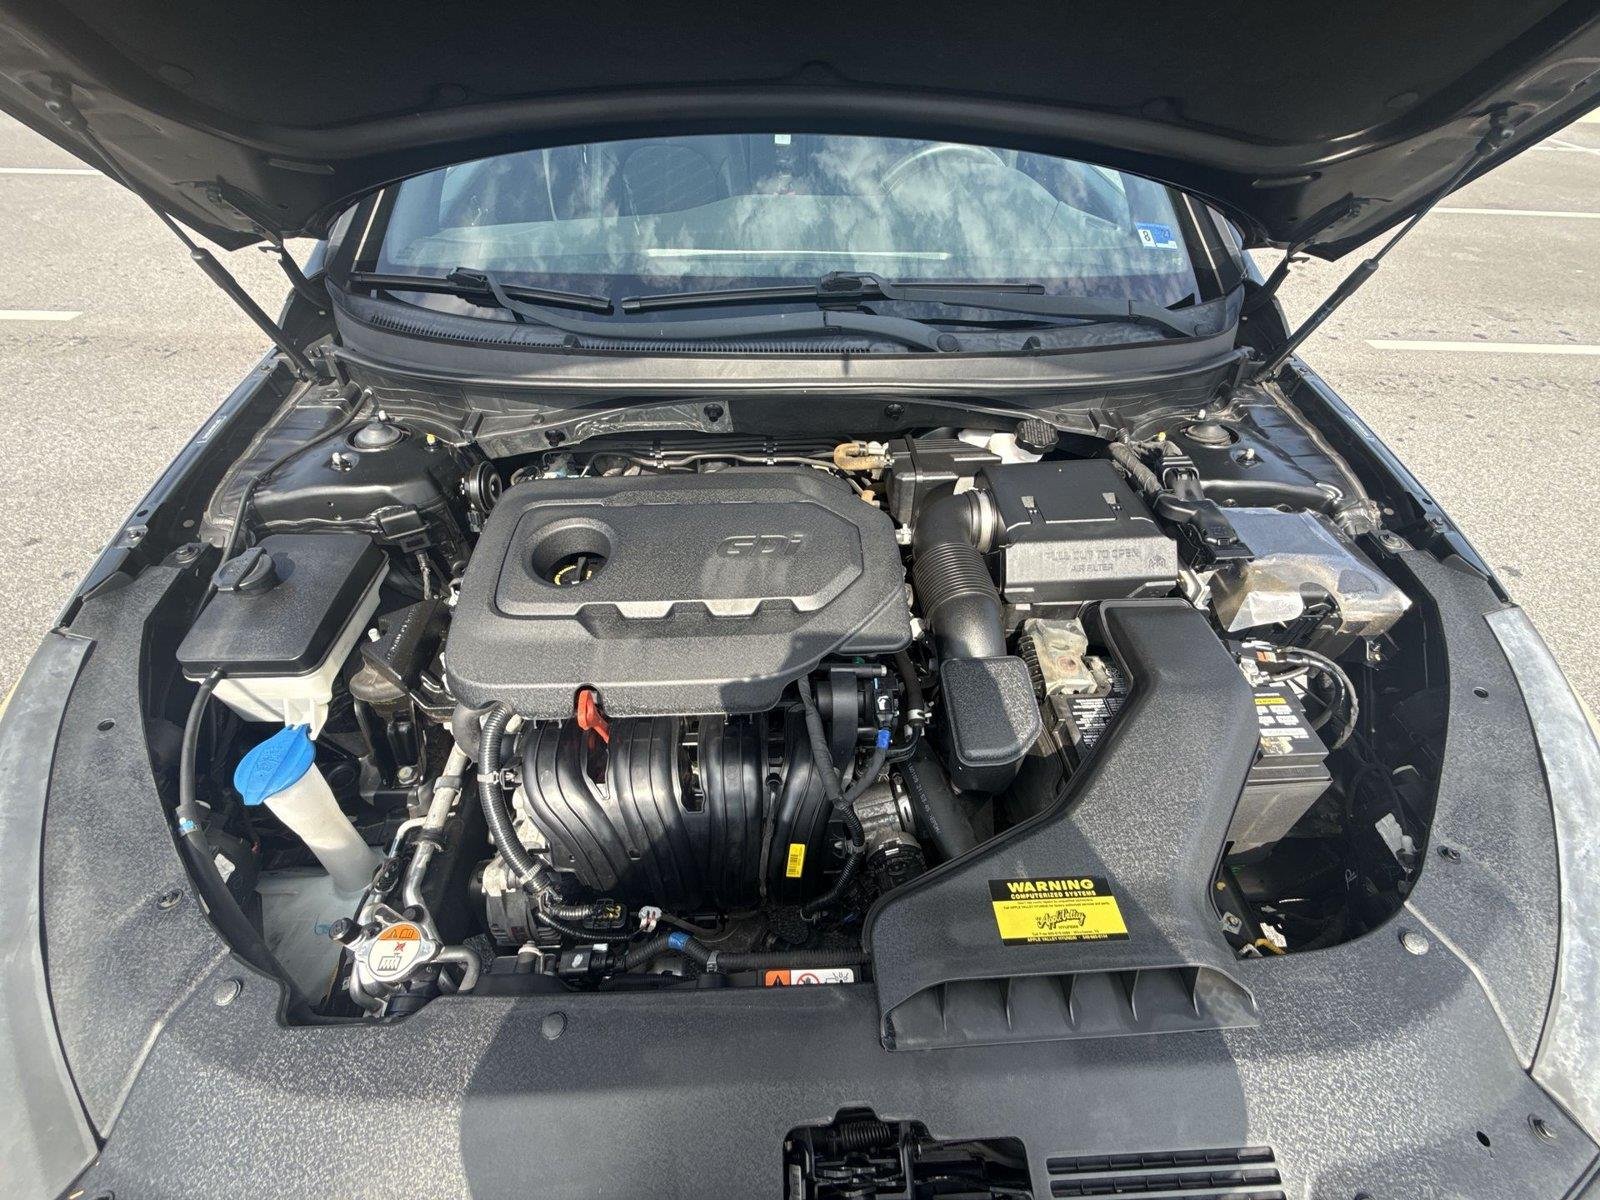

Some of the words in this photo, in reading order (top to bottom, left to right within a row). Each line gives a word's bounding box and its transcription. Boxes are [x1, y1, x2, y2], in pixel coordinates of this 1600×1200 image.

[1007, 879, 1095, 893] WARNING
[1010, 892, 1064, 900] COMPUTERIZED
[1064, 890, 1097, 898] SYSTEMS
